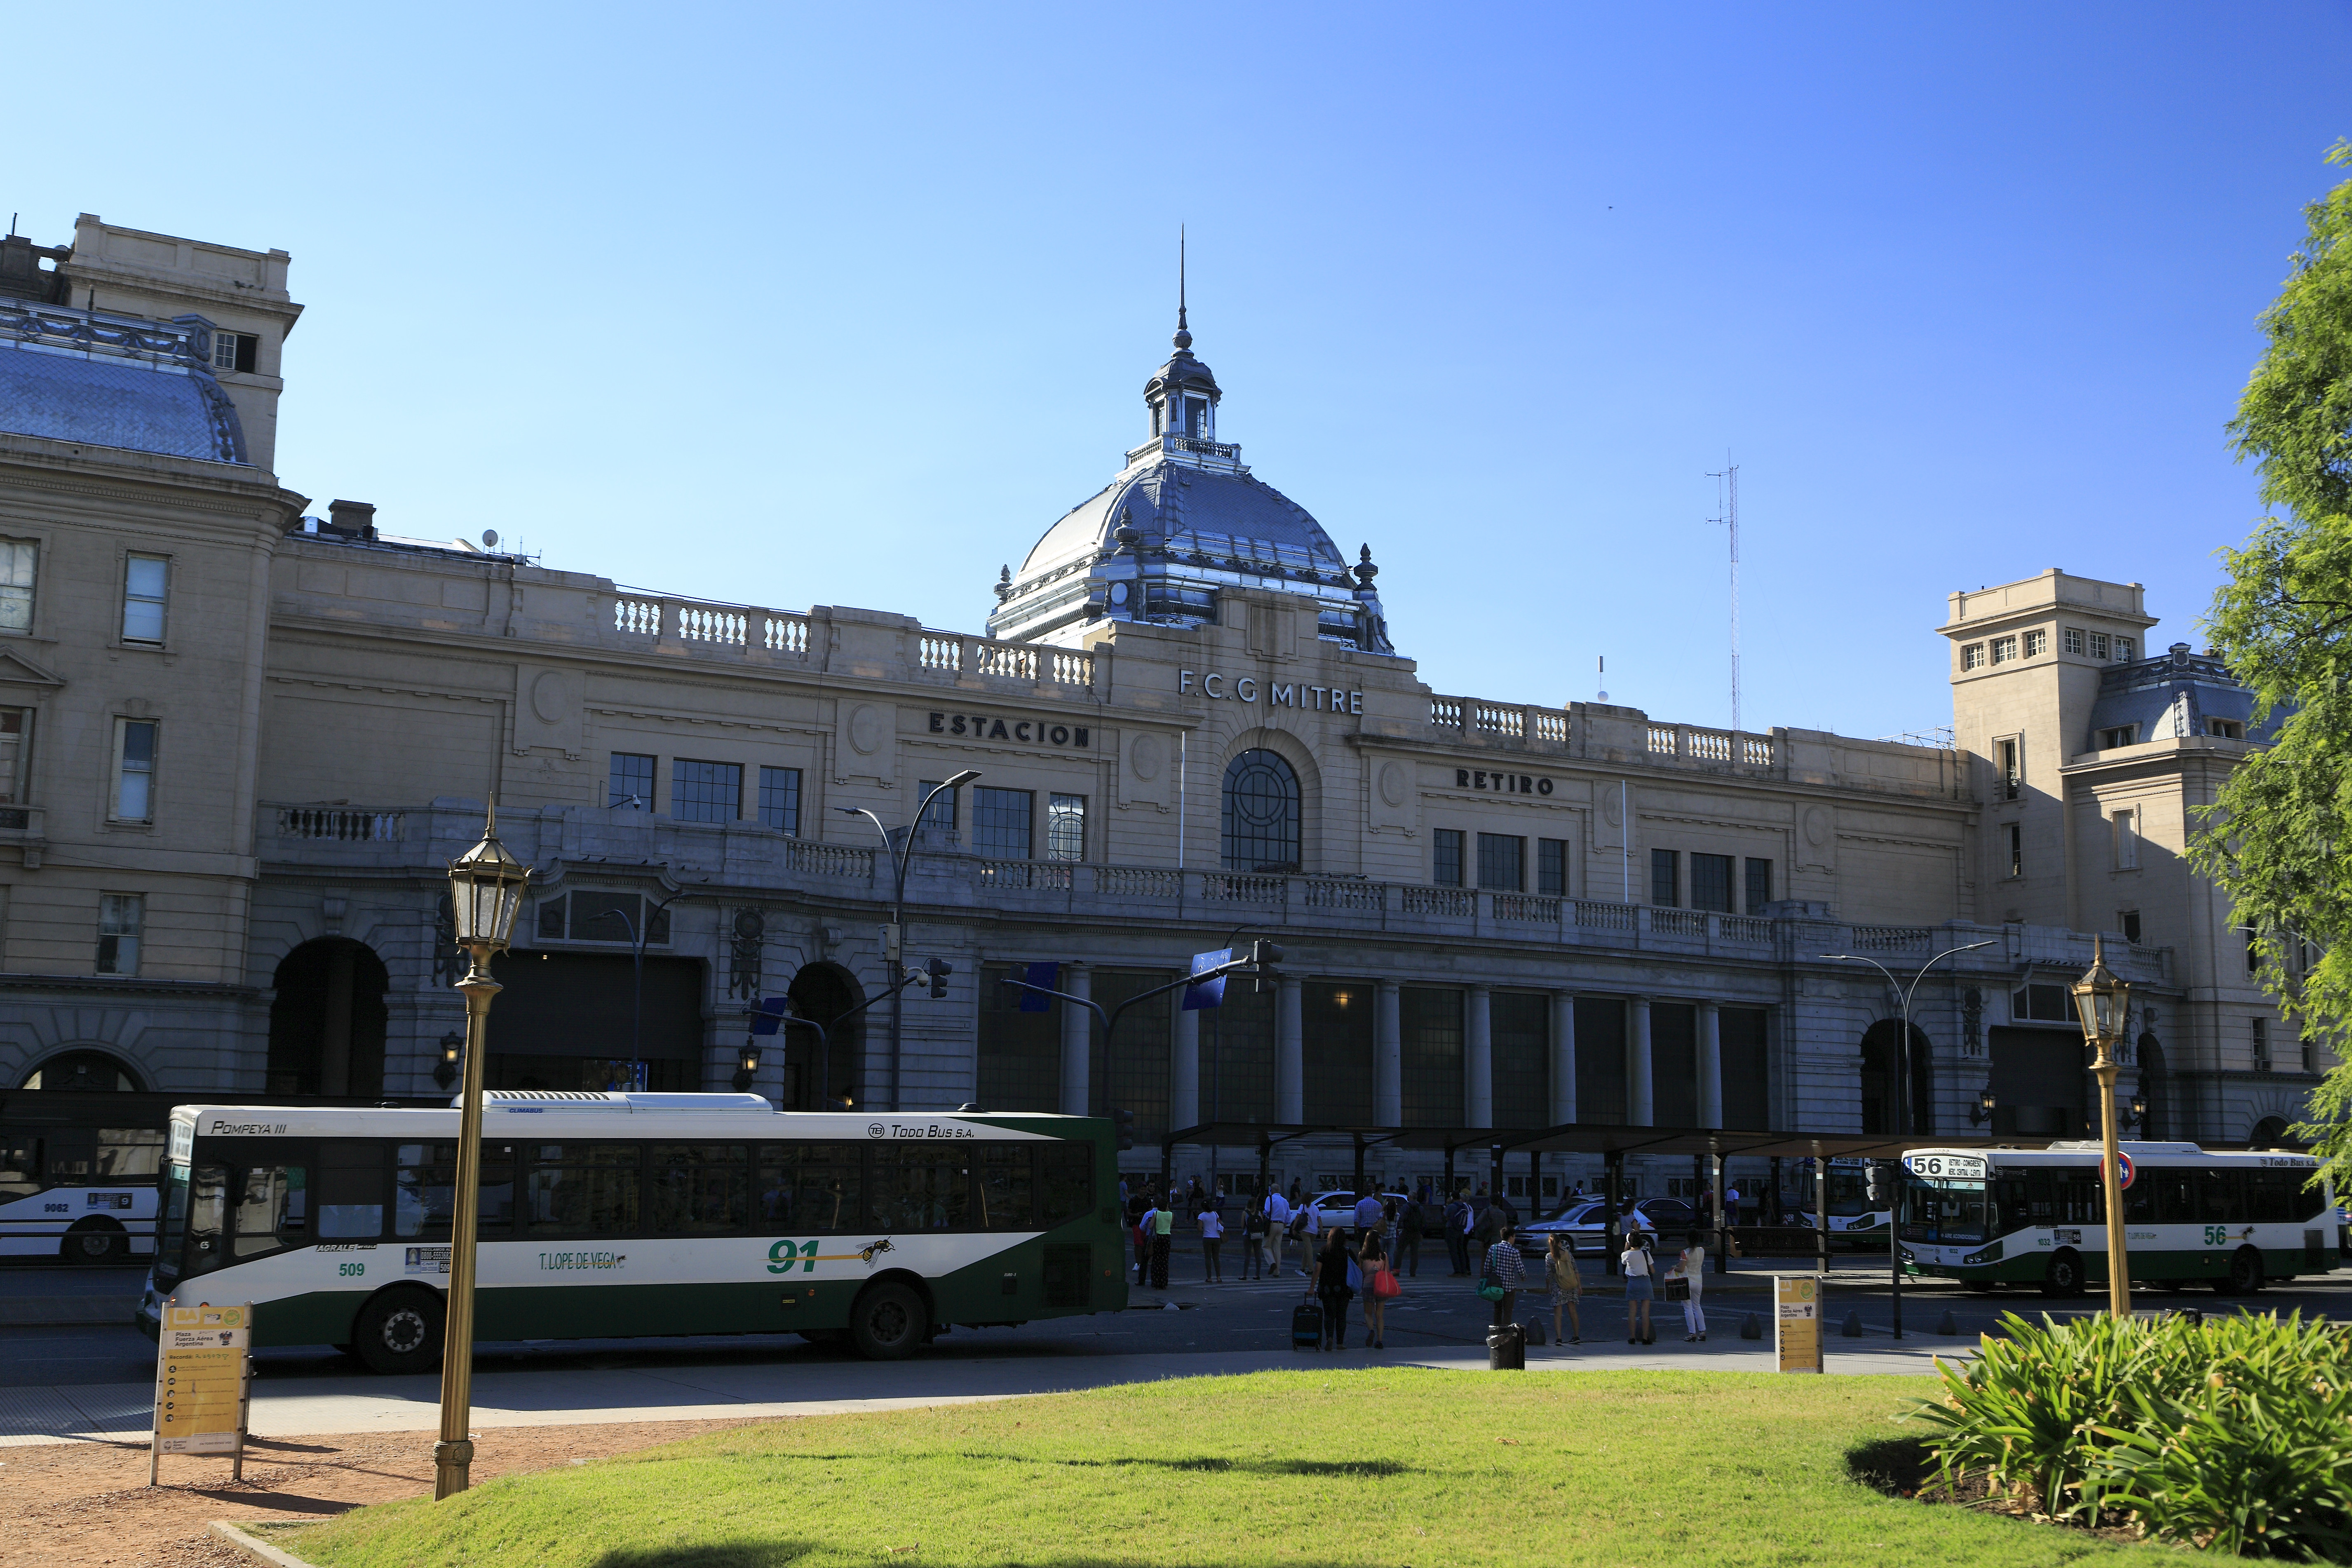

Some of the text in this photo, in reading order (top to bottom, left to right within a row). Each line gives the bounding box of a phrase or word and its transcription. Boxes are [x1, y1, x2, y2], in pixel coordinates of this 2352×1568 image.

[1271, 681, 1363, 715] MITRE
[930, 713, 1089, 747] ESTACION
[1457, 769, 1554, 795] RETIRO
[275, 1124, 287, 1134] III
[1914, 1158, 1942, 1174] 56
[2269, 1158, 2289, 1167] Todo
[2290, 1158, 2305, 1167] Bus
[44, 1203, 68, 1212] 9062
[2205, 1225, 2226, 1246] 56
[549, 1253, 574, 1270] LOPE
[575, 1252, 589, 1270] DE
[591, 1252, 616, 1269] VEGA
[766, 1240, 819, 1274] 91
[339, 1263, 365, 1277] 509
[440, 1263, 450, 1272] 509
